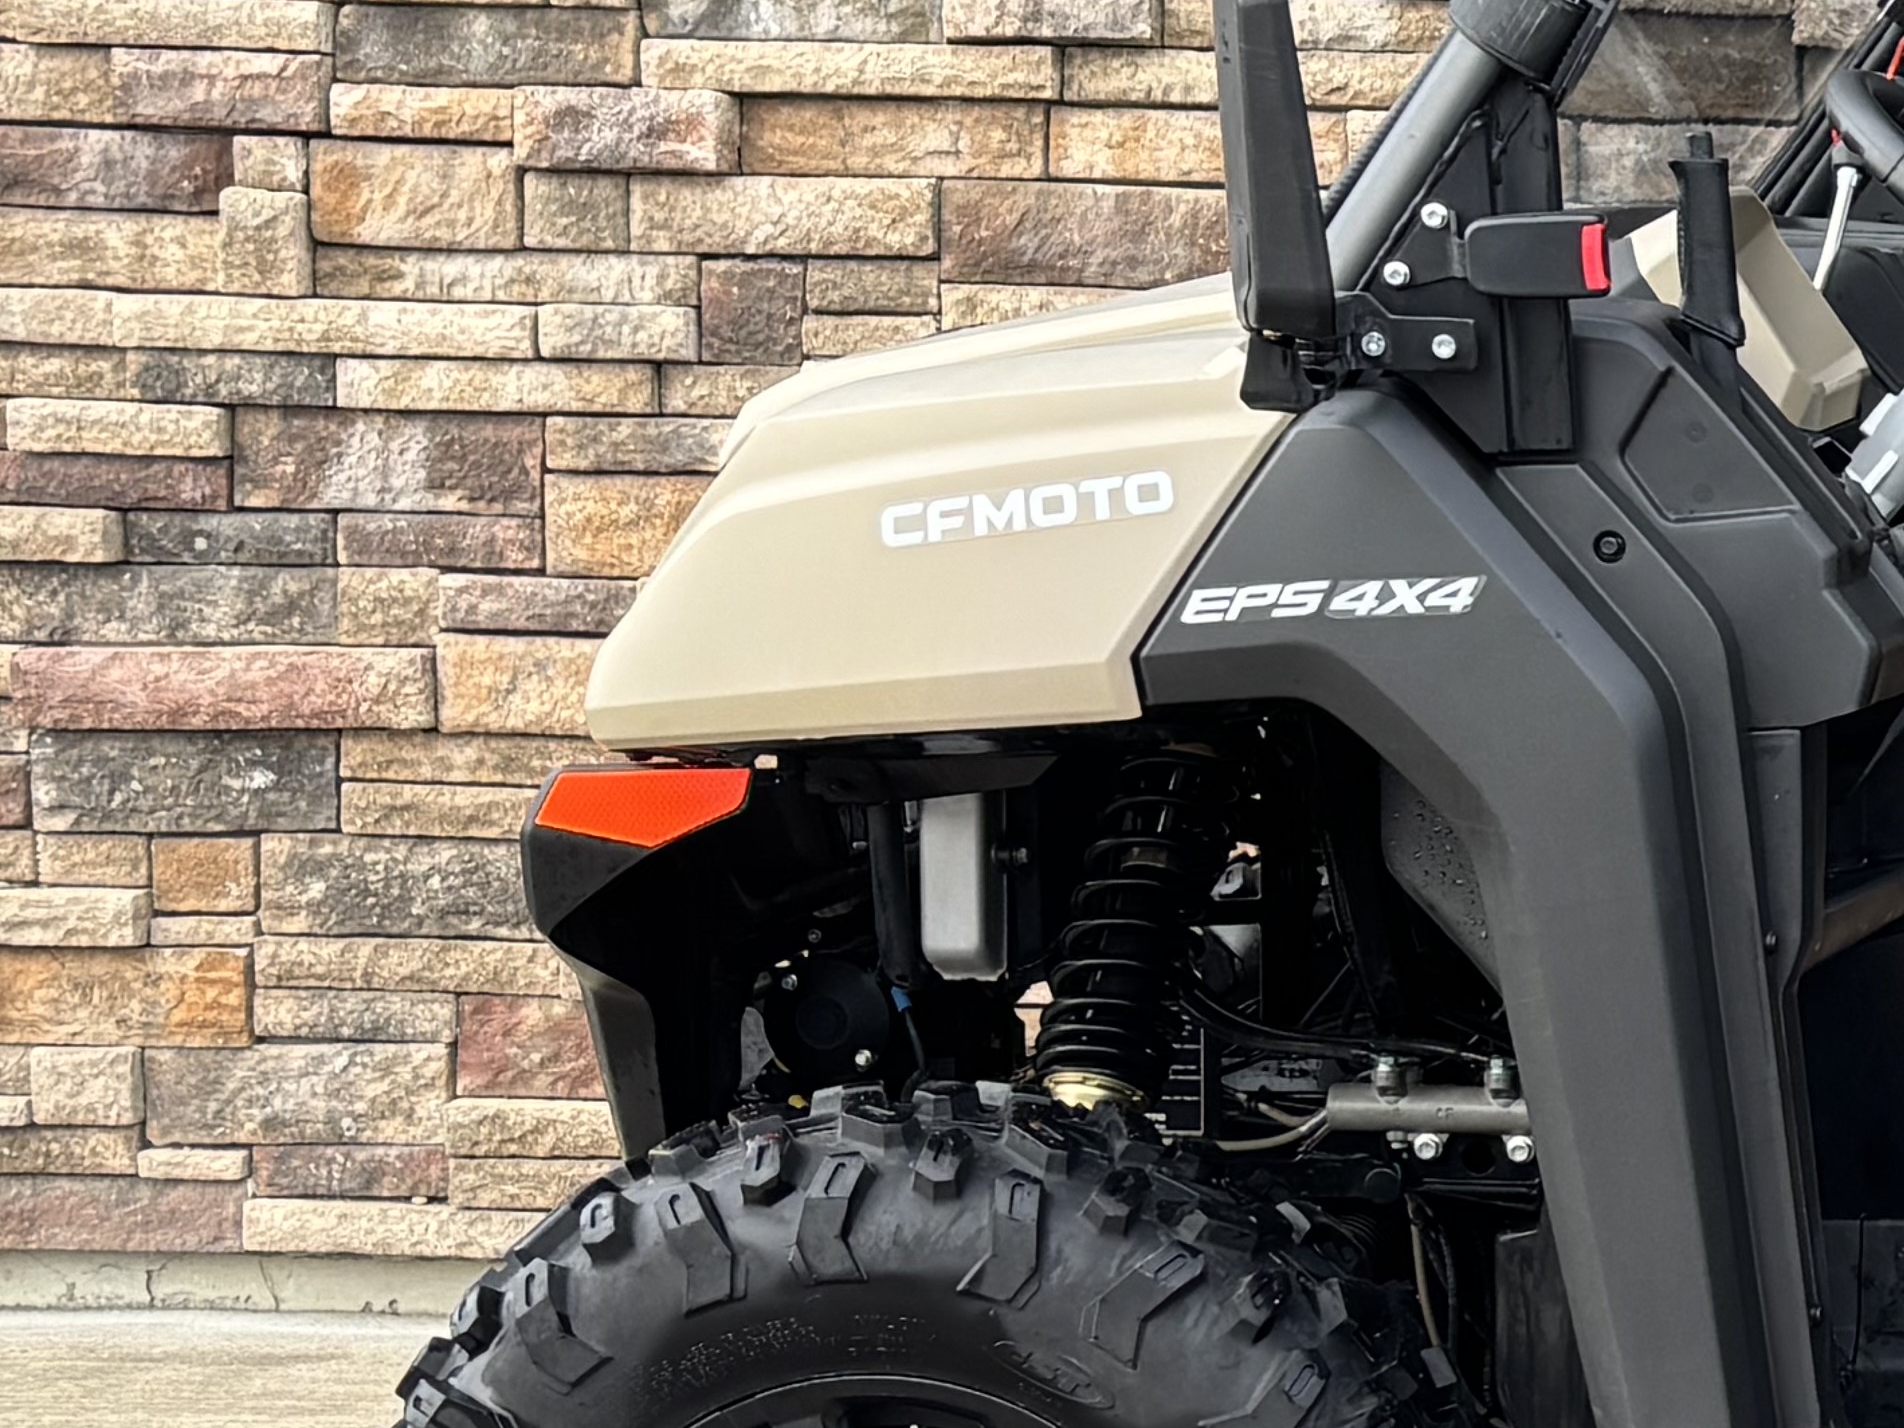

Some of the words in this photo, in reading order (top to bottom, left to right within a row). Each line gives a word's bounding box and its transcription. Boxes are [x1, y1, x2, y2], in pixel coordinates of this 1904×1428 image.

[880, 470, 1175, 548] CFMOTO
[1180, 580, 1331, 624] EPS
[1327, 575, 1480, 617] 4X4
